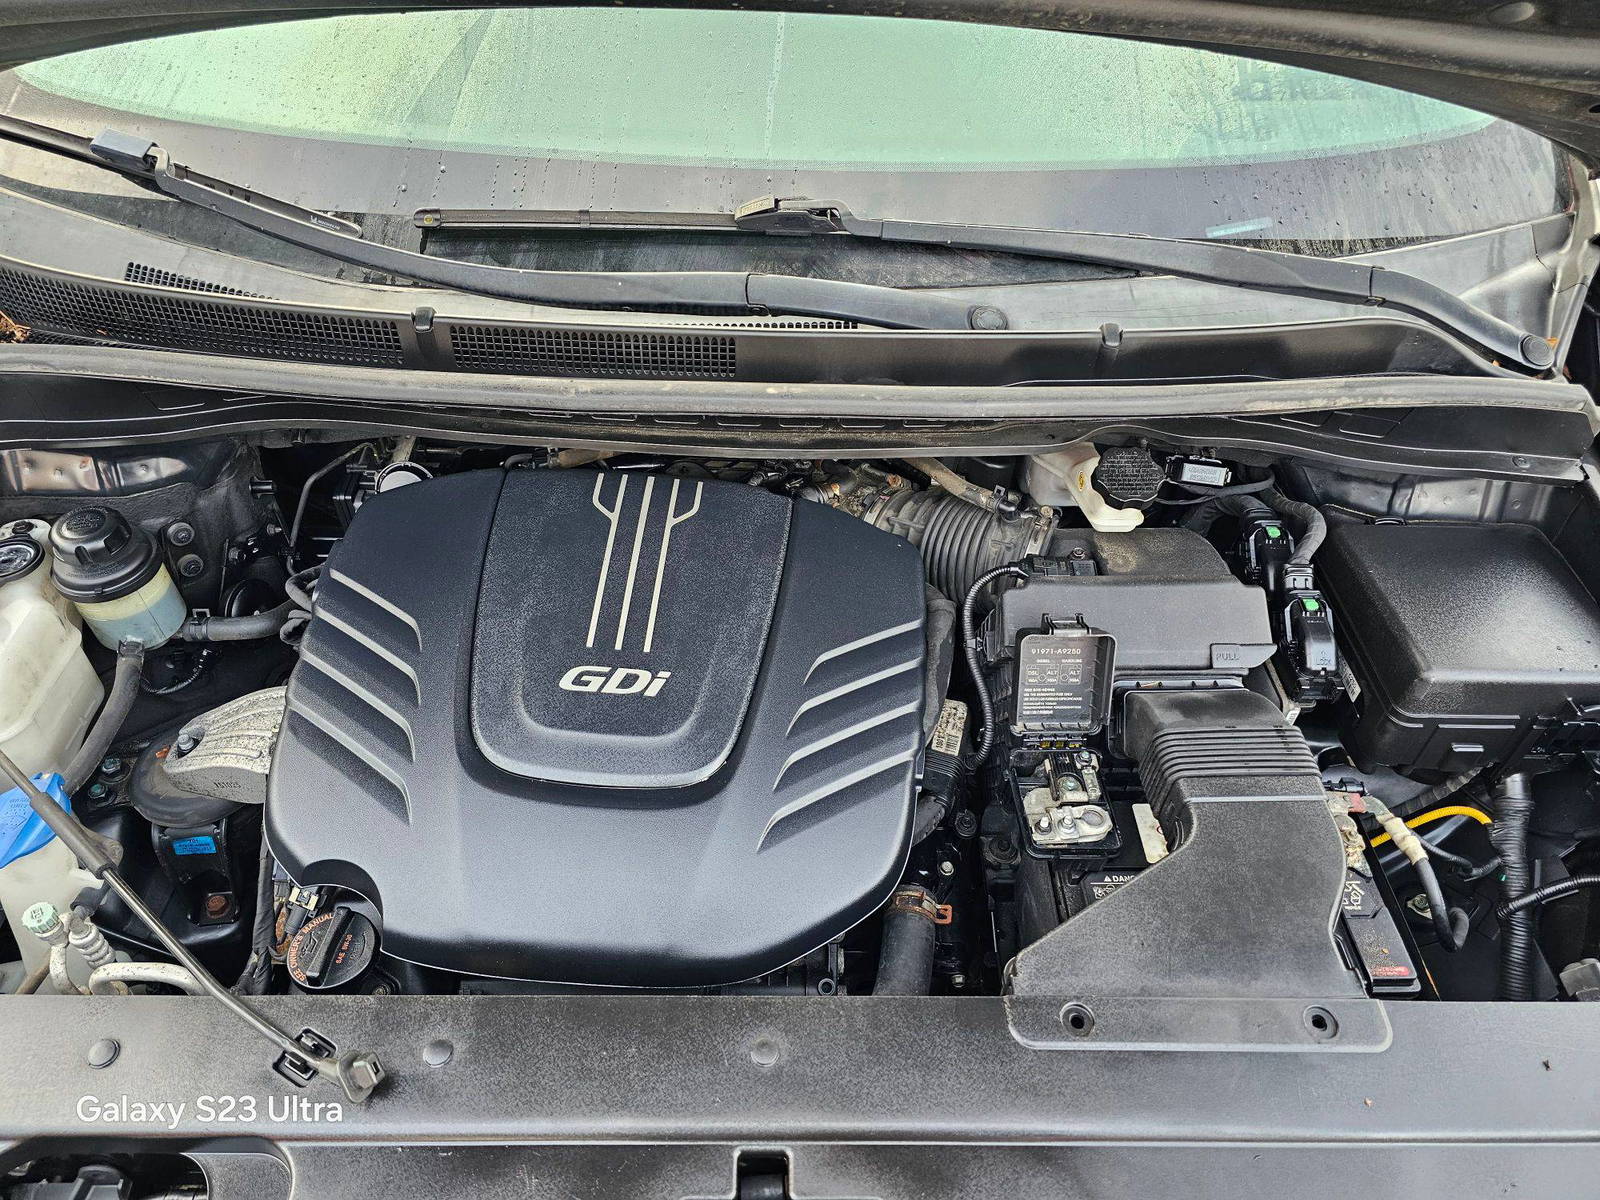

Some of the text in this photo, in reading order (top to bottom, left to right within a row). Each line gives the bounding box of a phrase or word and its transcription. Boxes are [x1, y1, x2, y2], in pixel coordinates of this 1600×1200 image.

[1216, 653, 1241, 661] PULL
[559, 665, 672, 697] GDi
[293, 968, 307, 982] SEE
[301, 912, 334, 934] MANUAL
[335, 951, 346, 964] SAE
